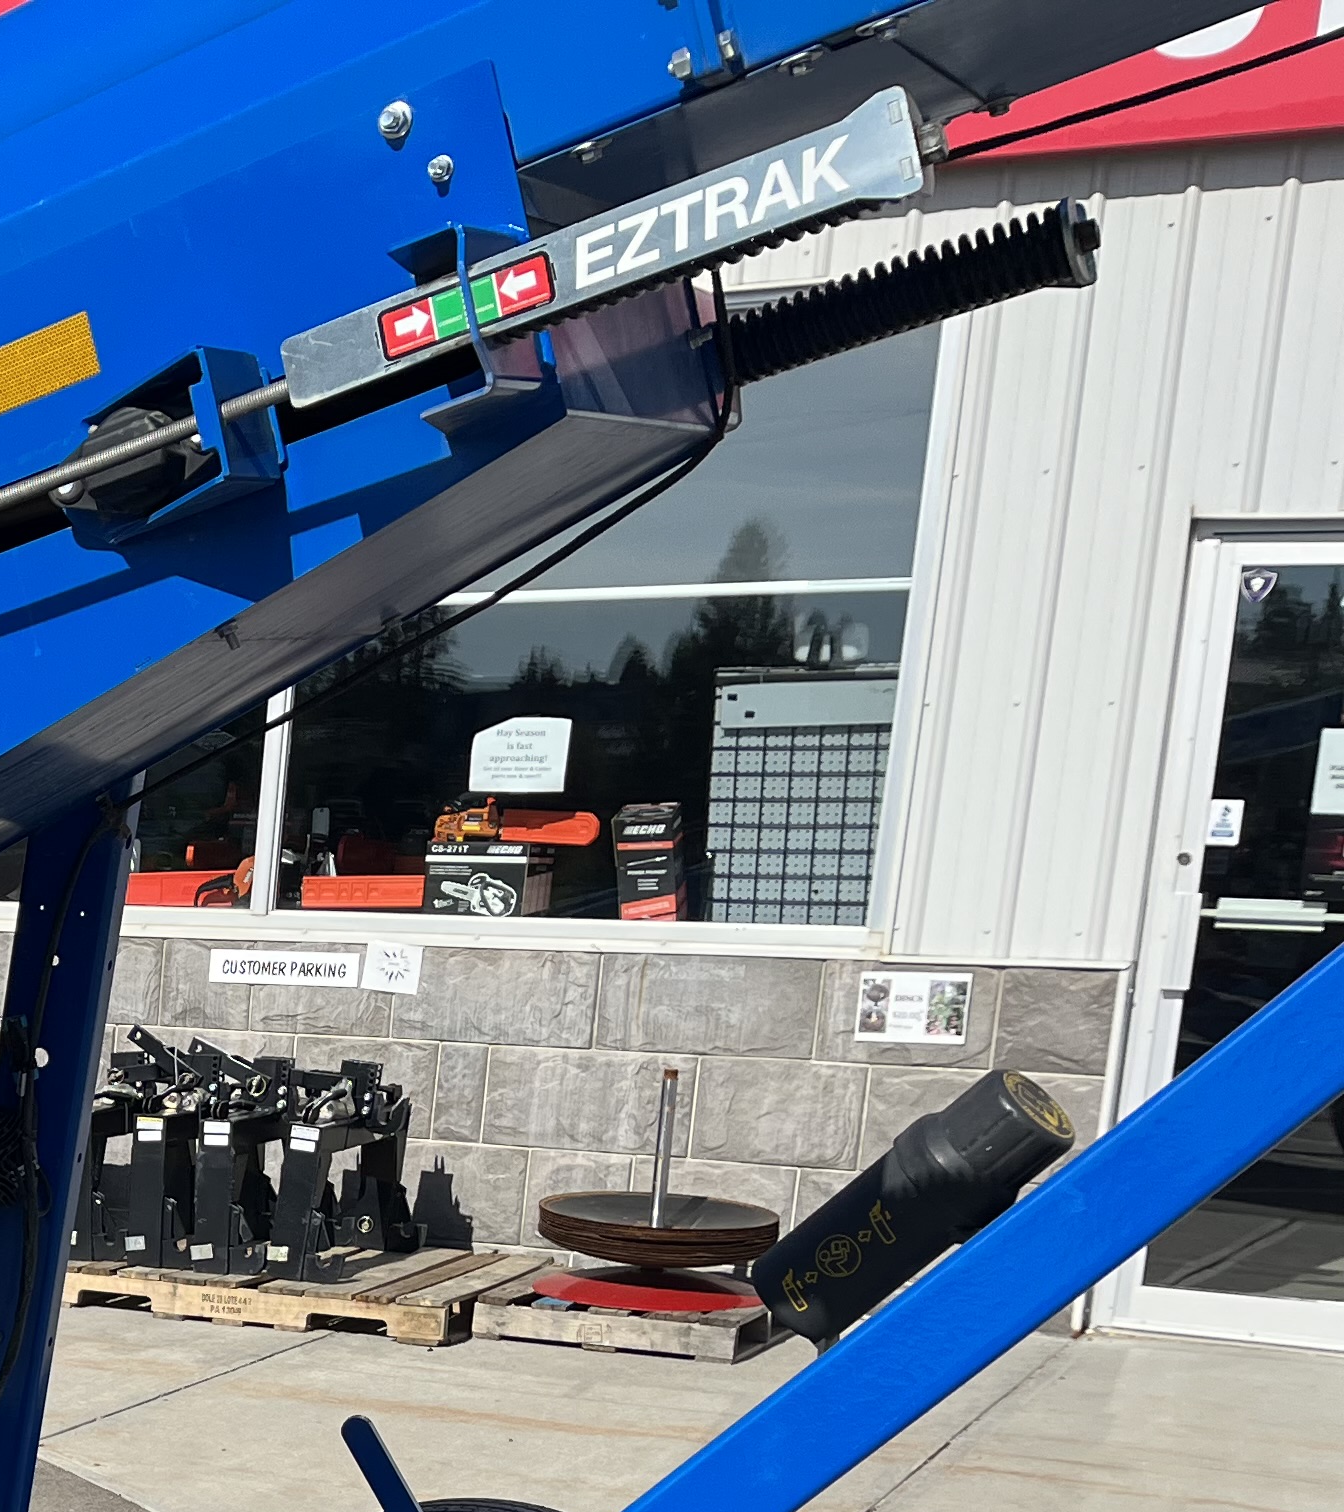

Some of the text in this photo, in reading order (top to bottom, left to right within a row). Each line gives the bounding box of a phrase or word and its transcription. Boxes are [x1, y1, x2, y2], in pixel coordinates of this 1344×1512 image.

[572, 134, 851, 291] EZTRAK
[496, 729, 546, 738] Hay Season
[506, 742, 533, 750] is fast
[628, 823, 666, 835] ECHO
[490, 845, 523, 854] ECHO
[222, 959, 347, 979] CUSTOMER PARKING
